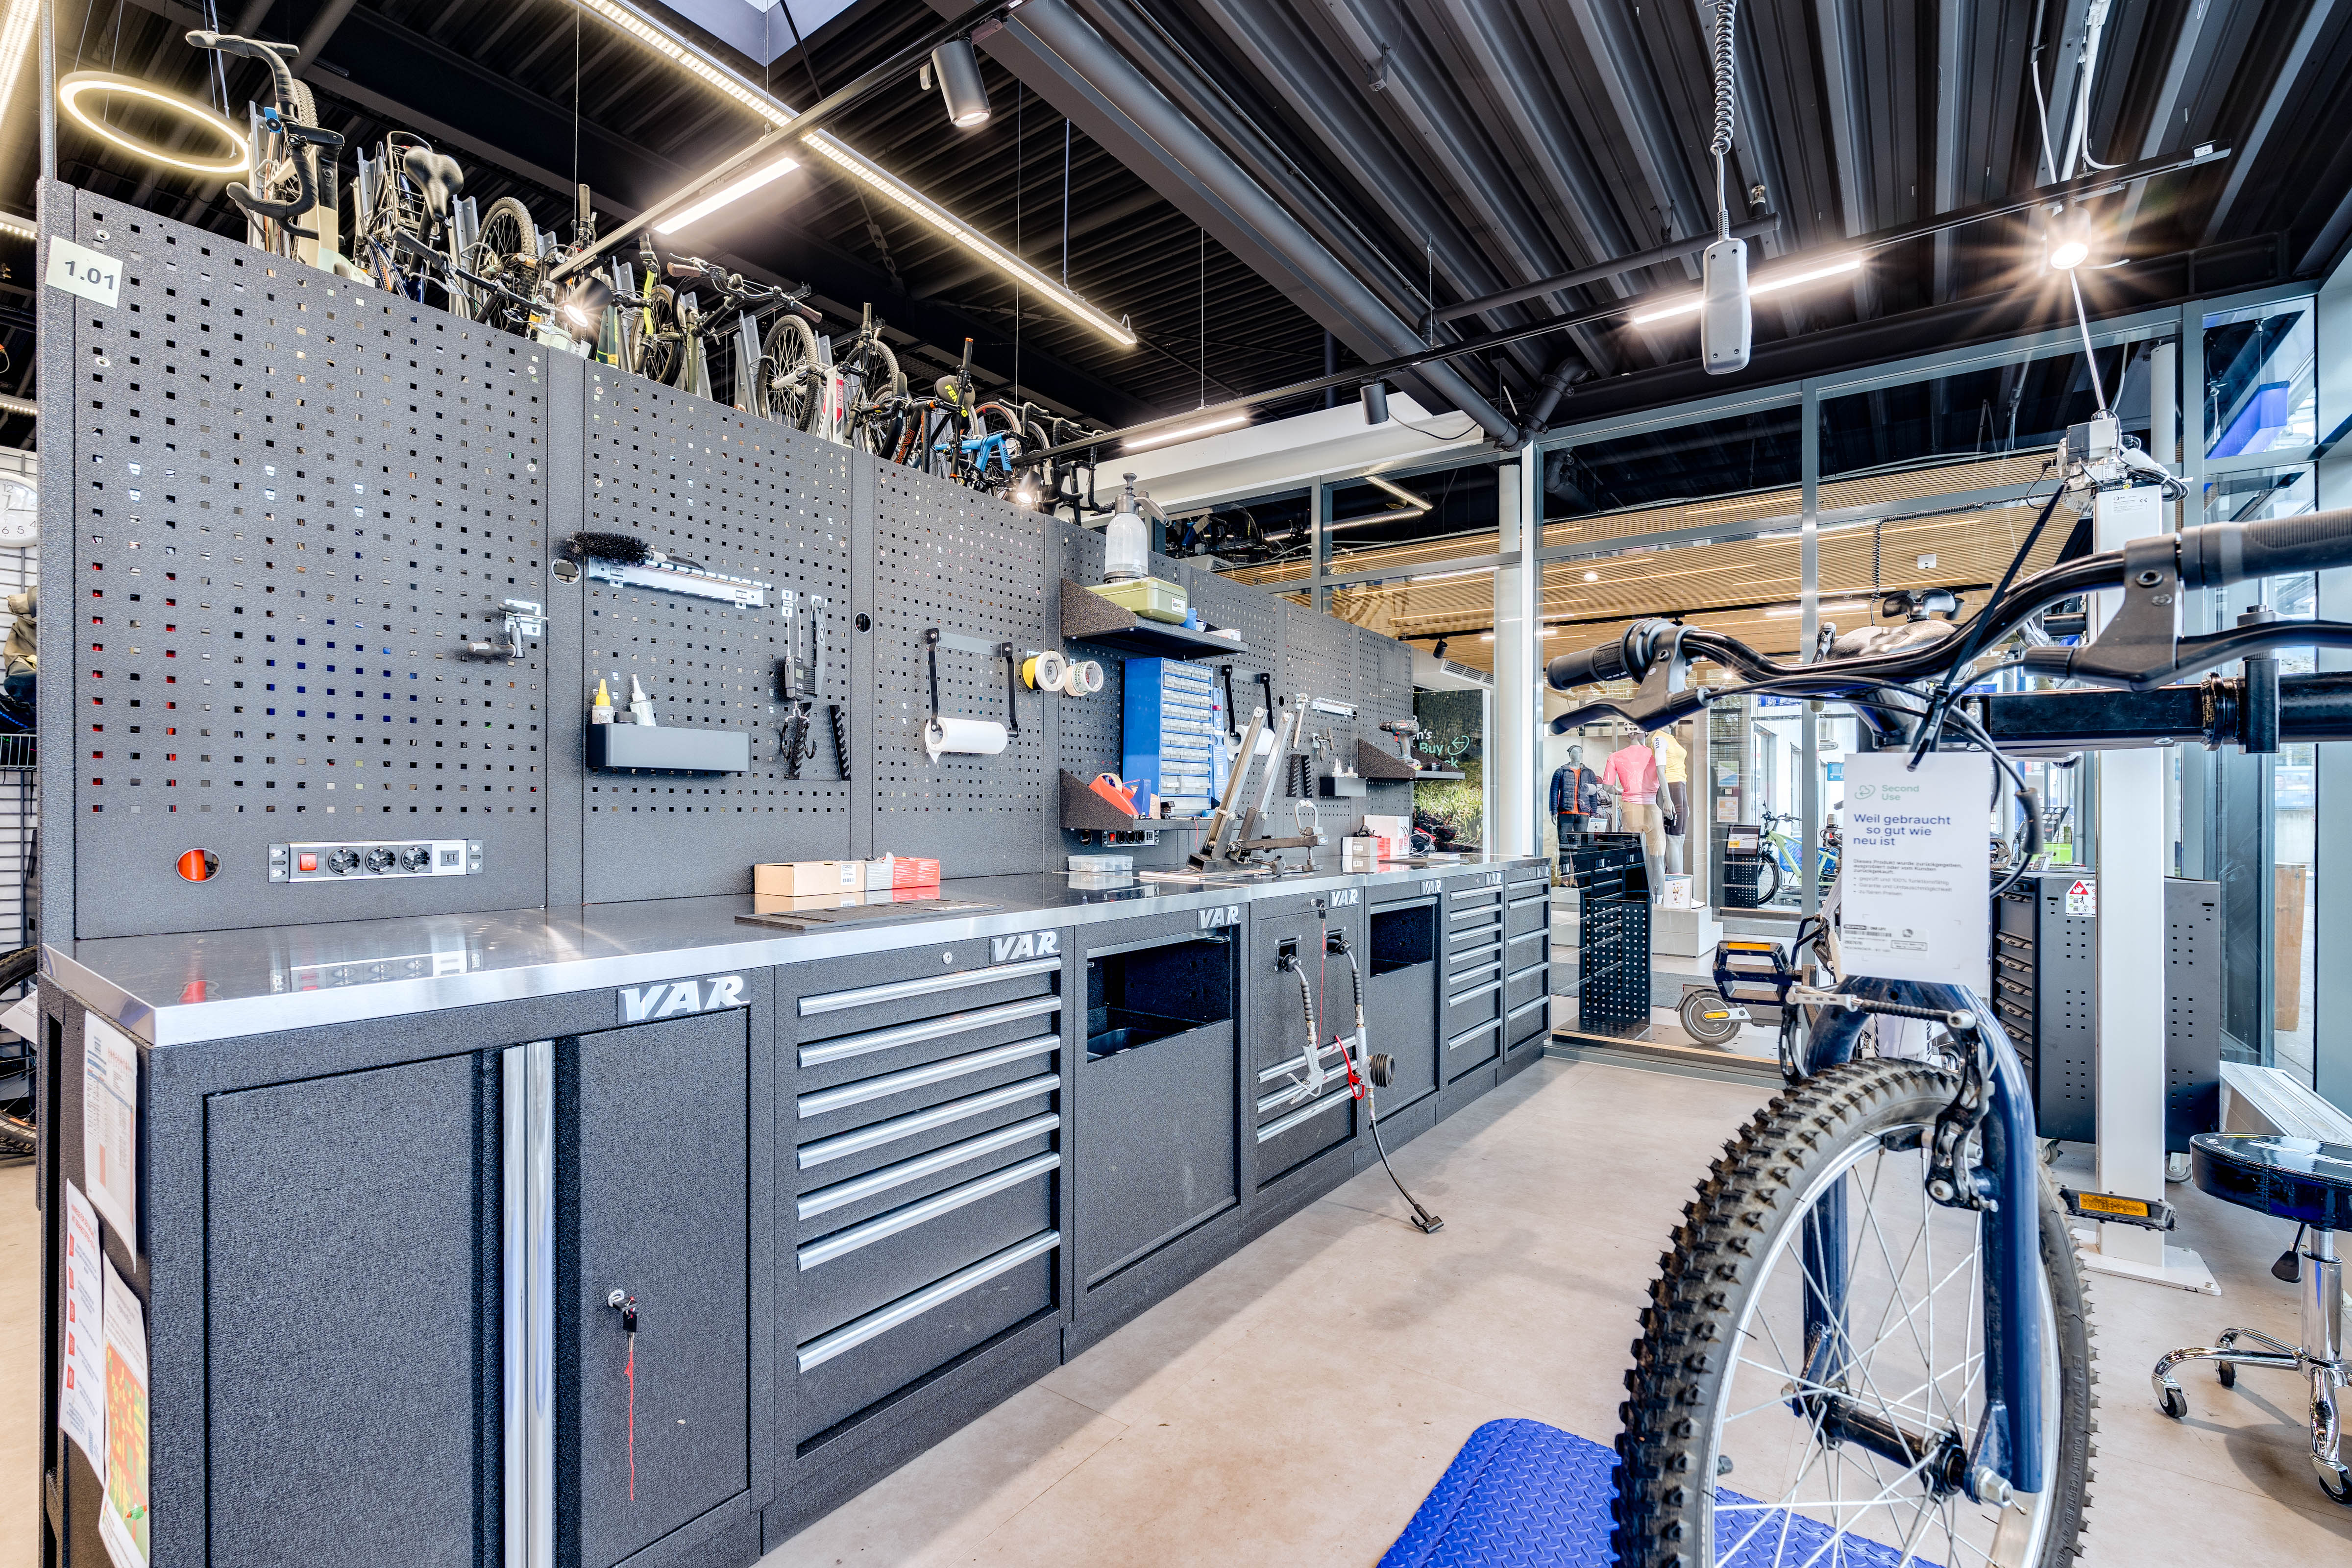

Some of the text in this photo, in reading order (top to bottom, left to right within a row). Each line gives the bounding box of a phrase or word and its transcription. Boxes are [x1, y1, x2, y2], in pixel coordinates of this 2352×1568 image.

[65, 261, 114, 290] 1.01
[2, 484, 13, 493] 12
[17, 526, 24, 534] 5
[1419, 742, 1444, 756] Buy
[1854, 813, 1952, 826] Weil gebraucht
[1885, 827, 1906, 836] gut
[1910, 827, 1932, 835] wie
[1853, 836, 1896, 846] neu ist
[1487, 873, 1501, 884] VAR
[1537, 867, 1549, 877] VAR
[1421, 880, 1442, 894] VAR
[1331, 889, 1359, 906] VAR
[1199, 906, 1241, 930] VAR
[992, 931, 1061, 961] VAR
[620, 975, 750, 1022] VAR
[2071, 1438, 2082, 1478] QUALITY
[2064, 1480, 2079, 1525] CERTIFIED
